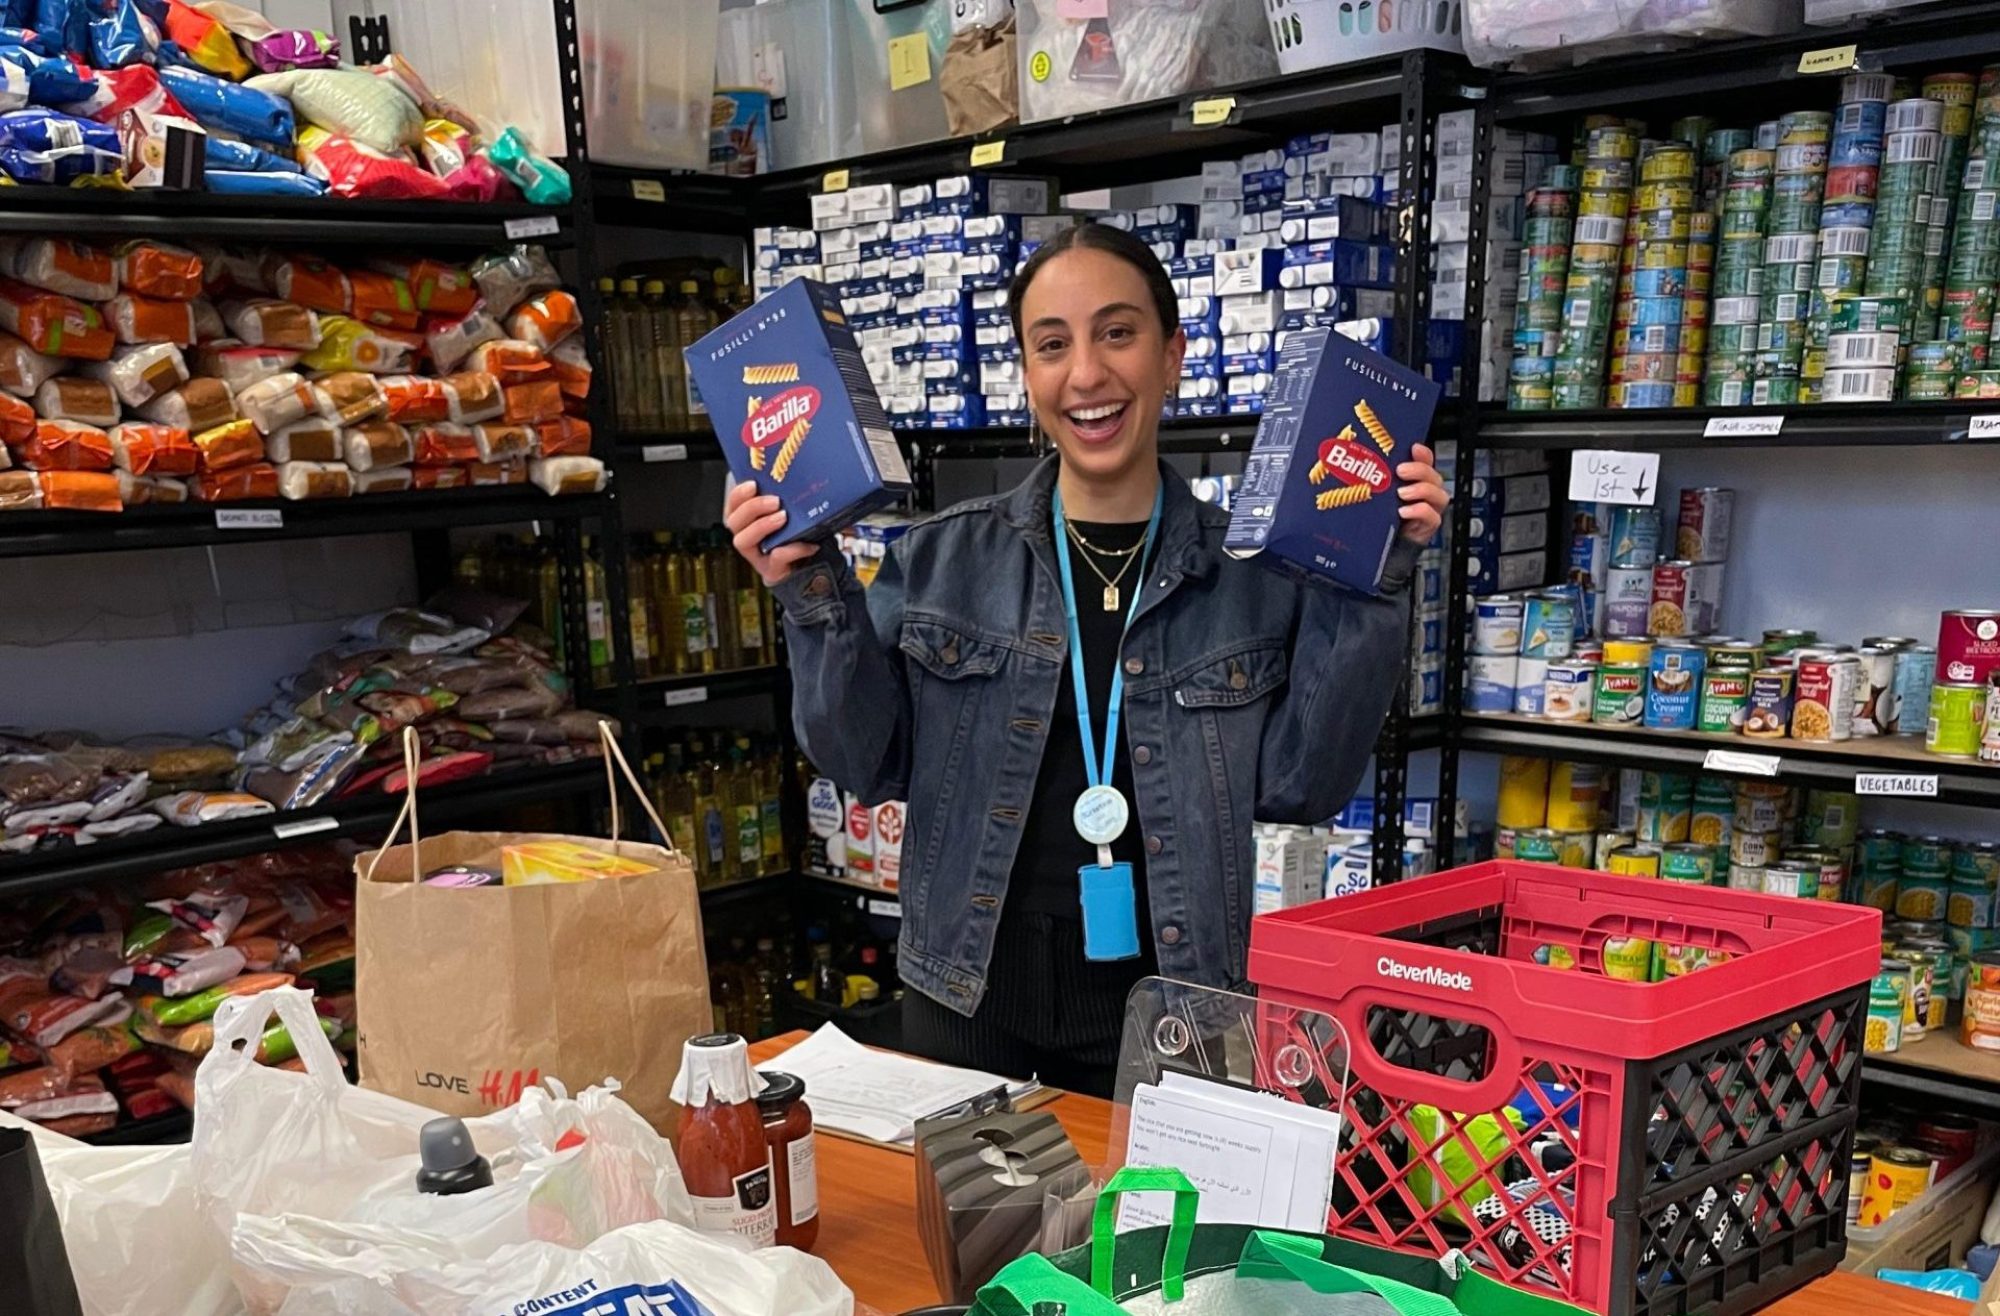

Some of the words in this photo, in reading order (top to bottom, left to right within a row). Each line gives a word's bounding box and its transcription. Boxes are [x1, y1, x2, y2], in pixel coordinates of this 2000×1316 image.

[710, 327, 755, 362] FUSILLI
[1344, 357, 1388, 387] FUSILLI
[751, 394, 812, 444] Barilla
[1325, 444, 1386, 487] Barilla
[1587, 457, 1627, 475] Use
[1593, 478, 1625, 499] 1st
[1602, 677, 1631, 692] AYAM
[1706, 682, 1735, 697] AYAM
[1651, 693, 1690, 705] Coconut
[1653, 702, 1685, 713] Cream
[1704, 704, 1740, 715] COCONUT
[1704, 714, 1728, 724] CREAM
[1860, 776, 1934, 793] VEGETABLES
[1348, 872, 1368, 888] So
[1377, 957, 1472, 991] CleverMade
[415, 1068, 470, 1094] LOVE
[514, 1278, 598, 1316] CONTENT
